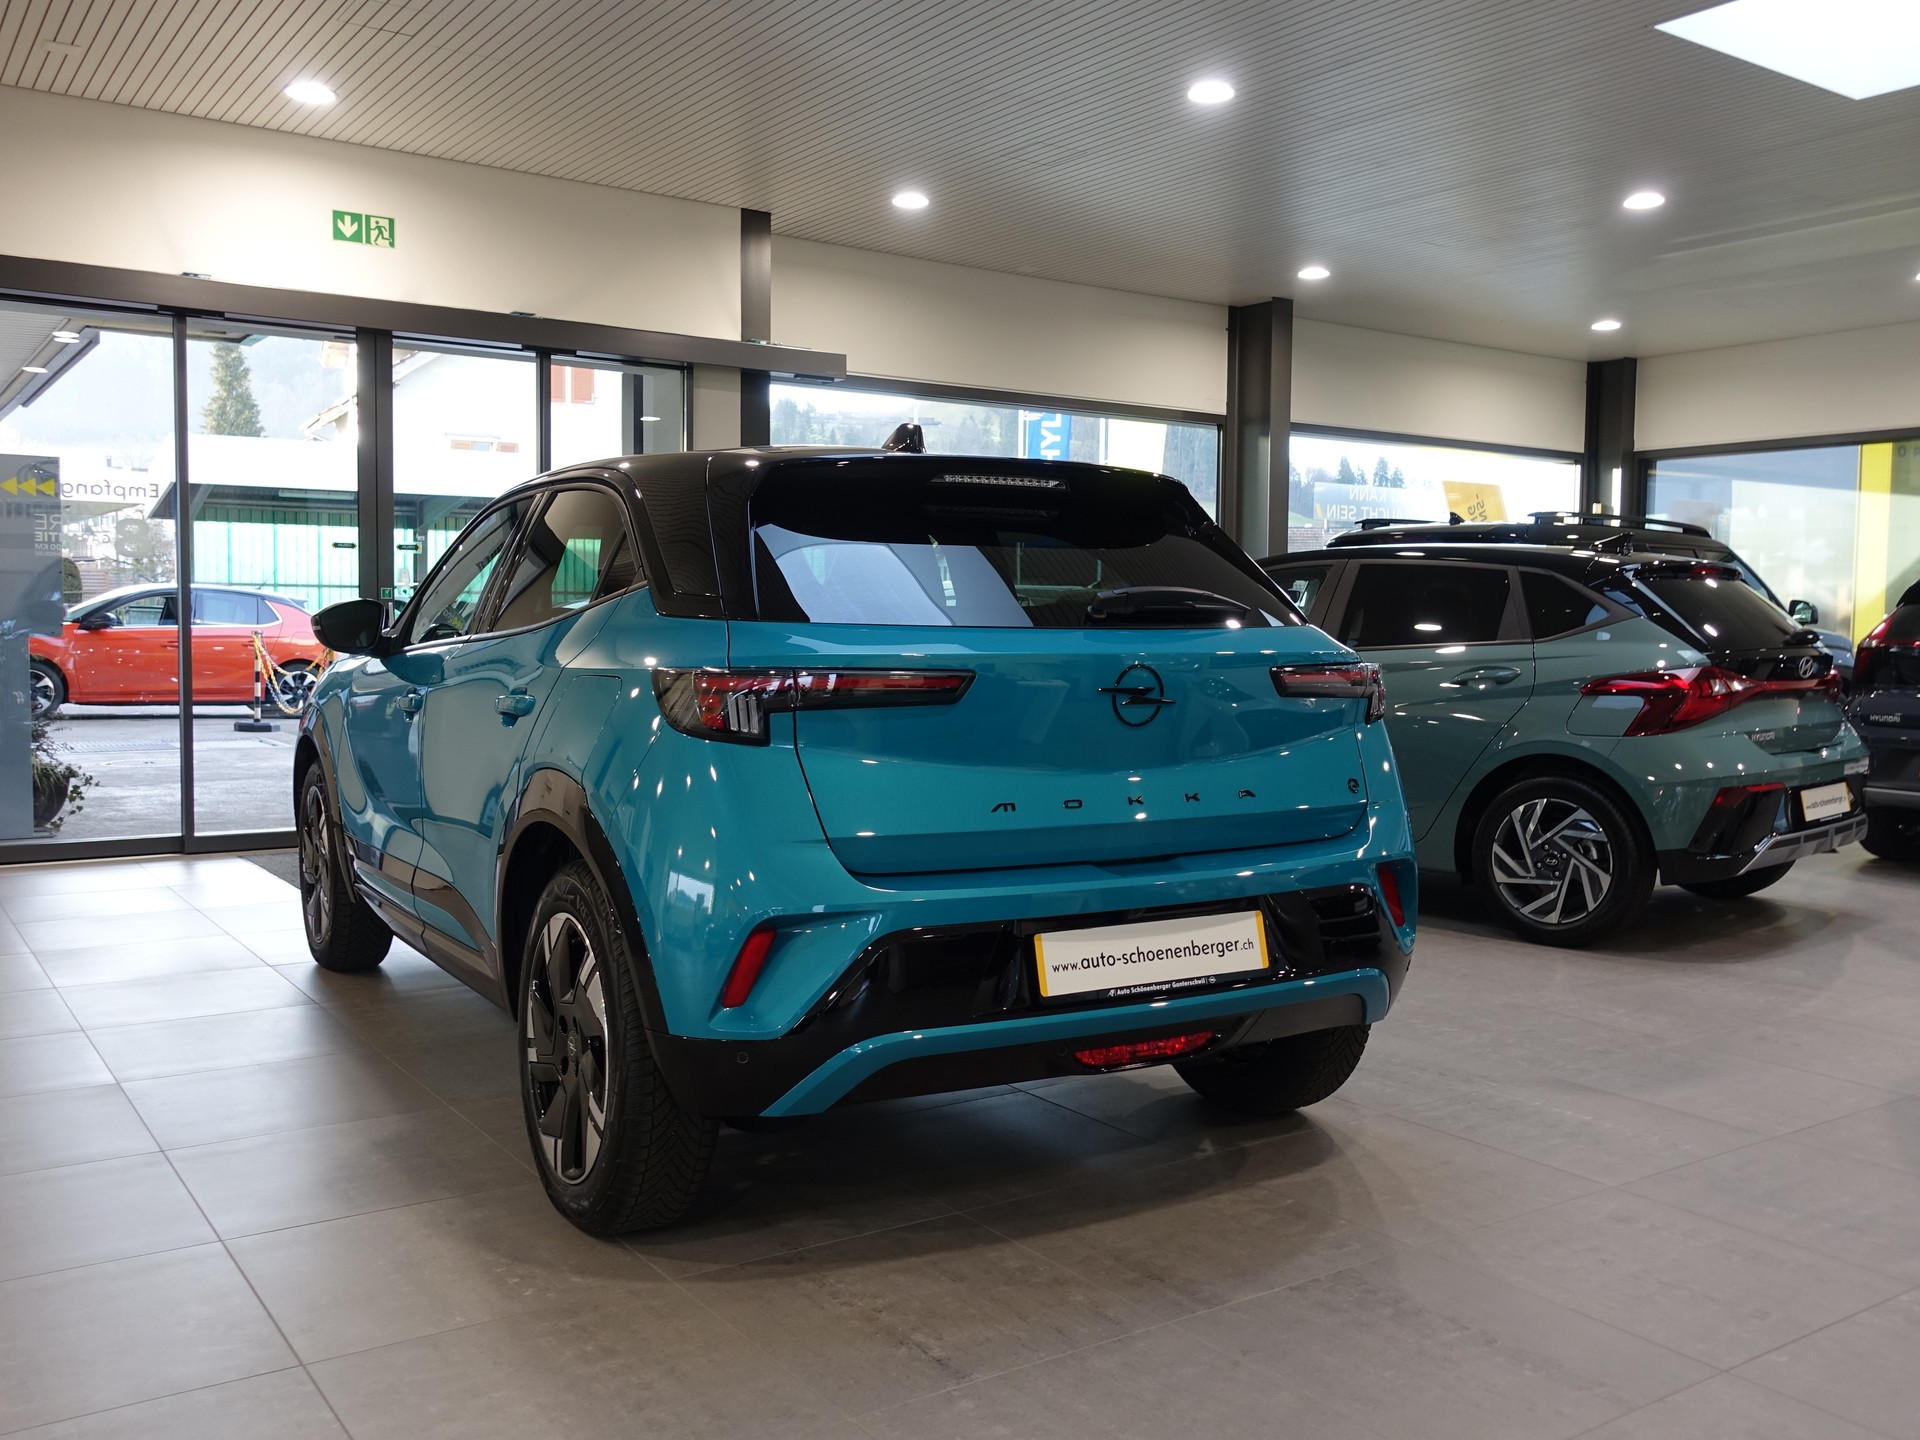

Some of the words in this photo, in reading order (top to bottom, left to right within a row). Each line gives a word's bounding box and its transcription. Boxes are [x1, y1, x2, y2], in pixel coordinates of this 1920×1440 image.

[990, 788, 1257, 813] MOKKA
[1051, 937, 1255, 974] www.auto-schoenenberger.ch
[1117, 987, 1131, 996] Auto
[1131, 982, 1171, 994] Schönenberger
